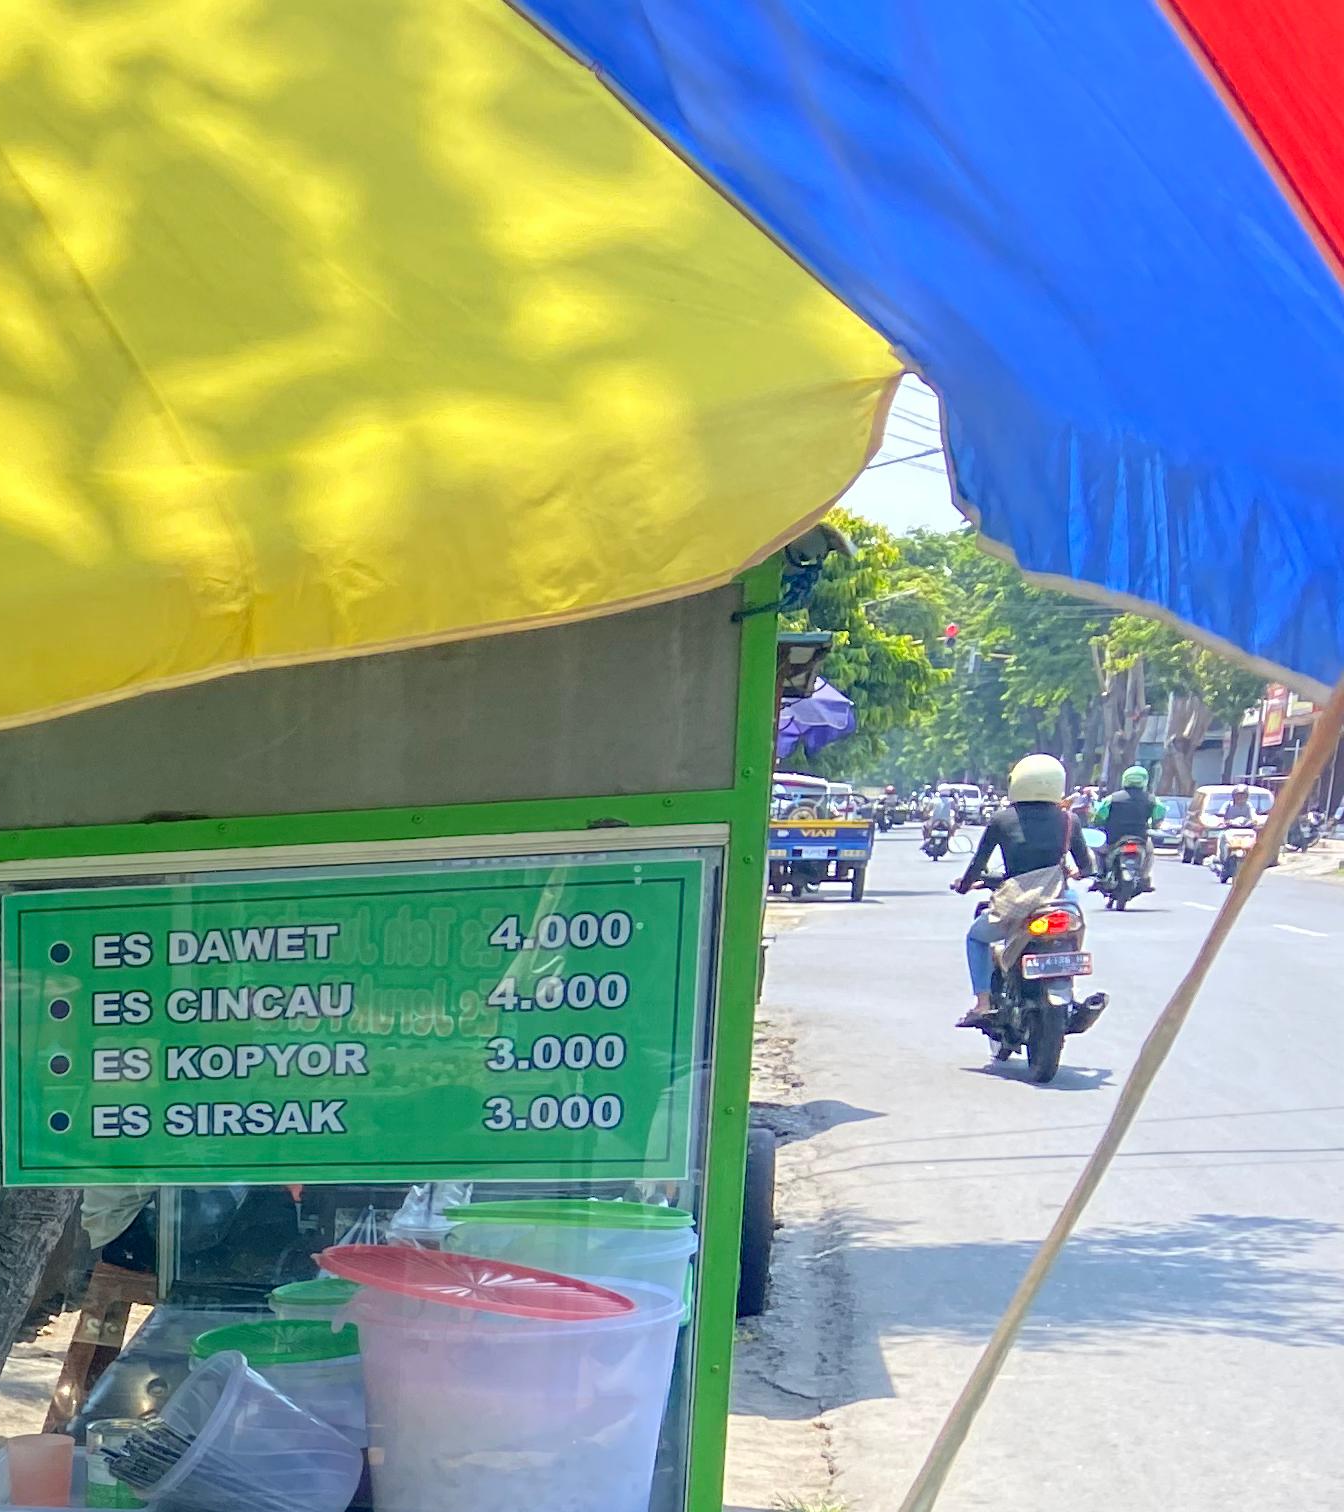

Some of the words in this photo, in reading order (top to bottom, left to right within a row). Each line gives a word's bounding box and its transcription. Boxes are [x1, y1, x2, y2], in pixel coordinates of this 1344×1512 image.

[800, 829, 837, 838] VIAR
[92, 932, 153, 968] ES
[167, 924, 339, 965] DAWET
[489, 911, 632, 949] 4.000
[92, 991, 152, 1025] ES
[166, 983, 354, 1022] CINCAU
[488, 973, 629, 1010] 4.000
[92, 1048, 152, 1081] ES
[166, 1042, 369, 1080] KOPYOR
[486, 1034, 625, 1070] 3.000
[92, 1104, 150, 1137] ES
[164, 1100, 347, 1136] SIRSAK
[483, 1094, 622, 1130] 3.000
